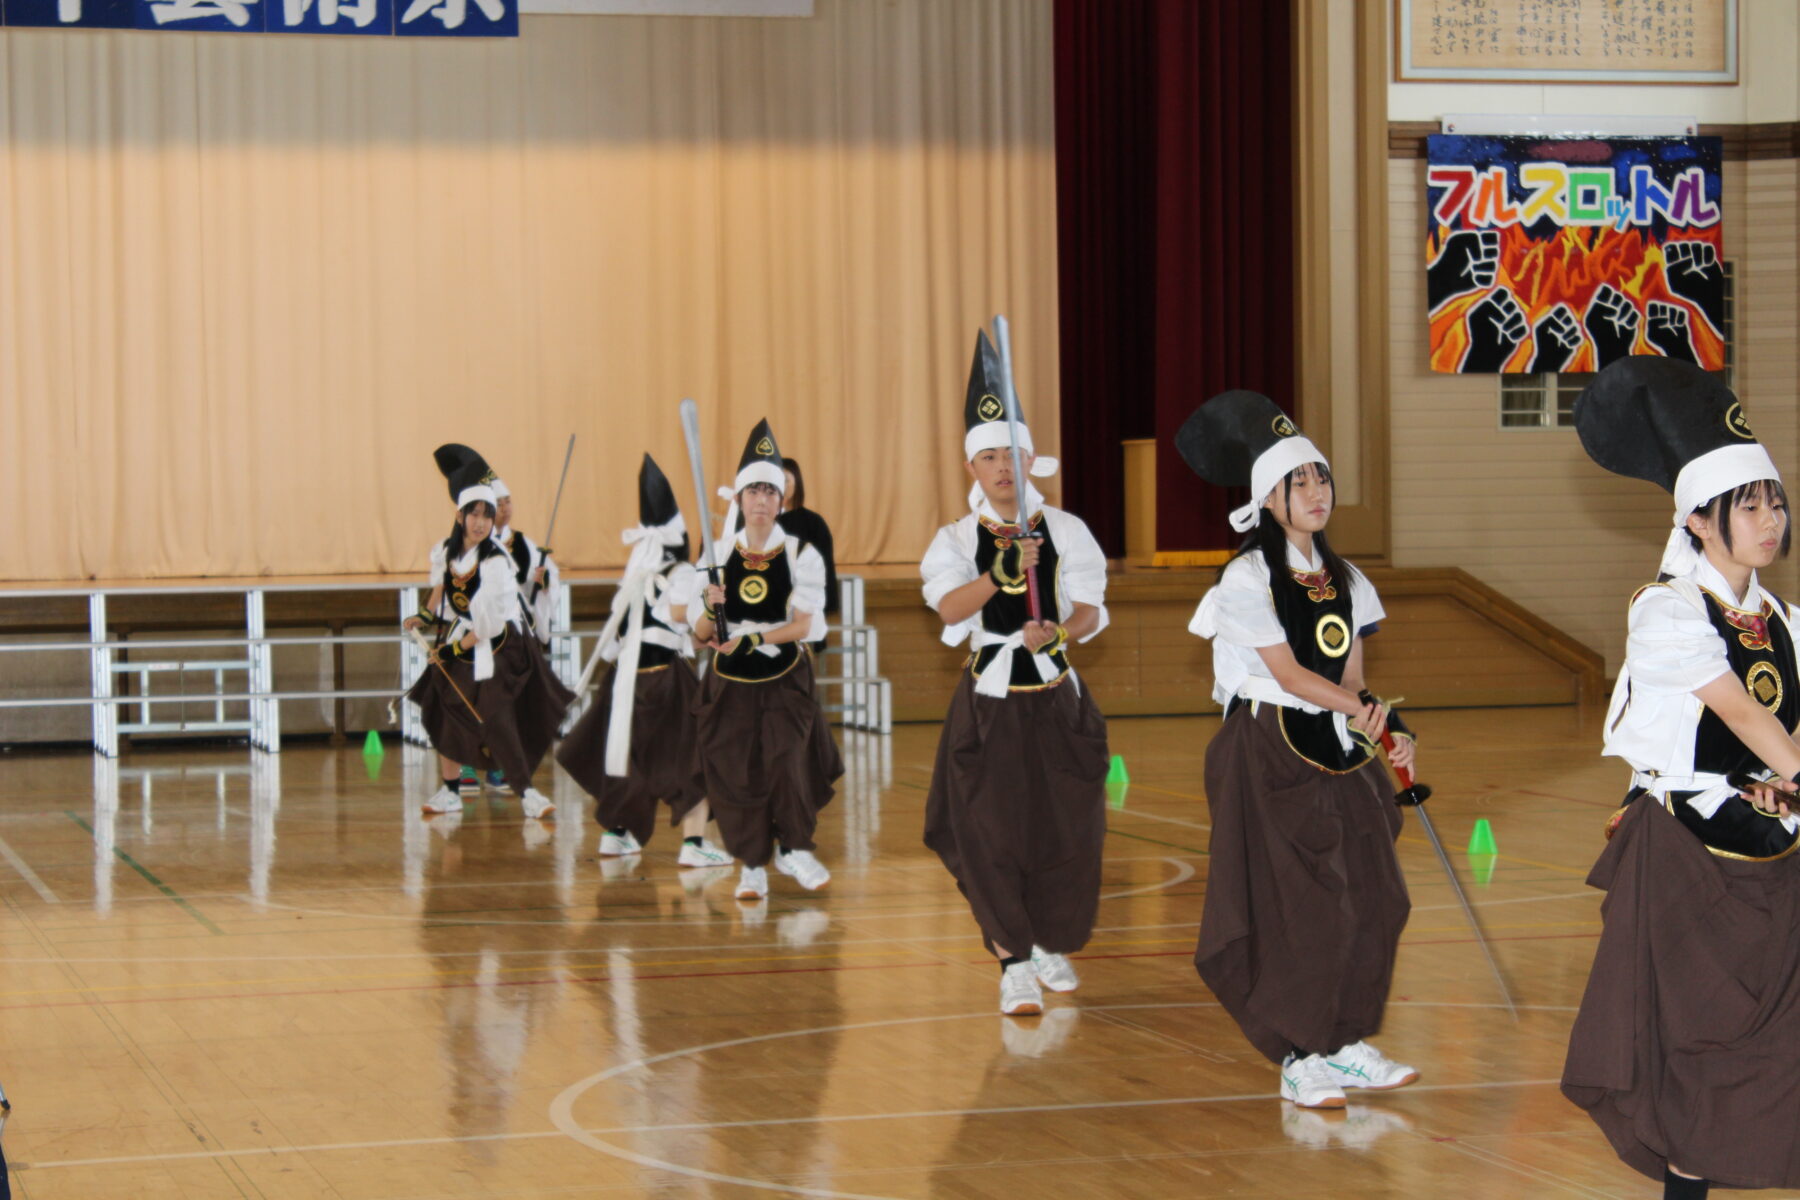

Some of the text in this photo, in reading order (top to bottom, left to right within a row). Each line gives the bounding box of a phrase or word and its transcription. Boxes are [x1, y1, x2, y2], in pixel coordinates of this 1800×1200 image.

[1429, 166, 1718, 230] フルスロットル
